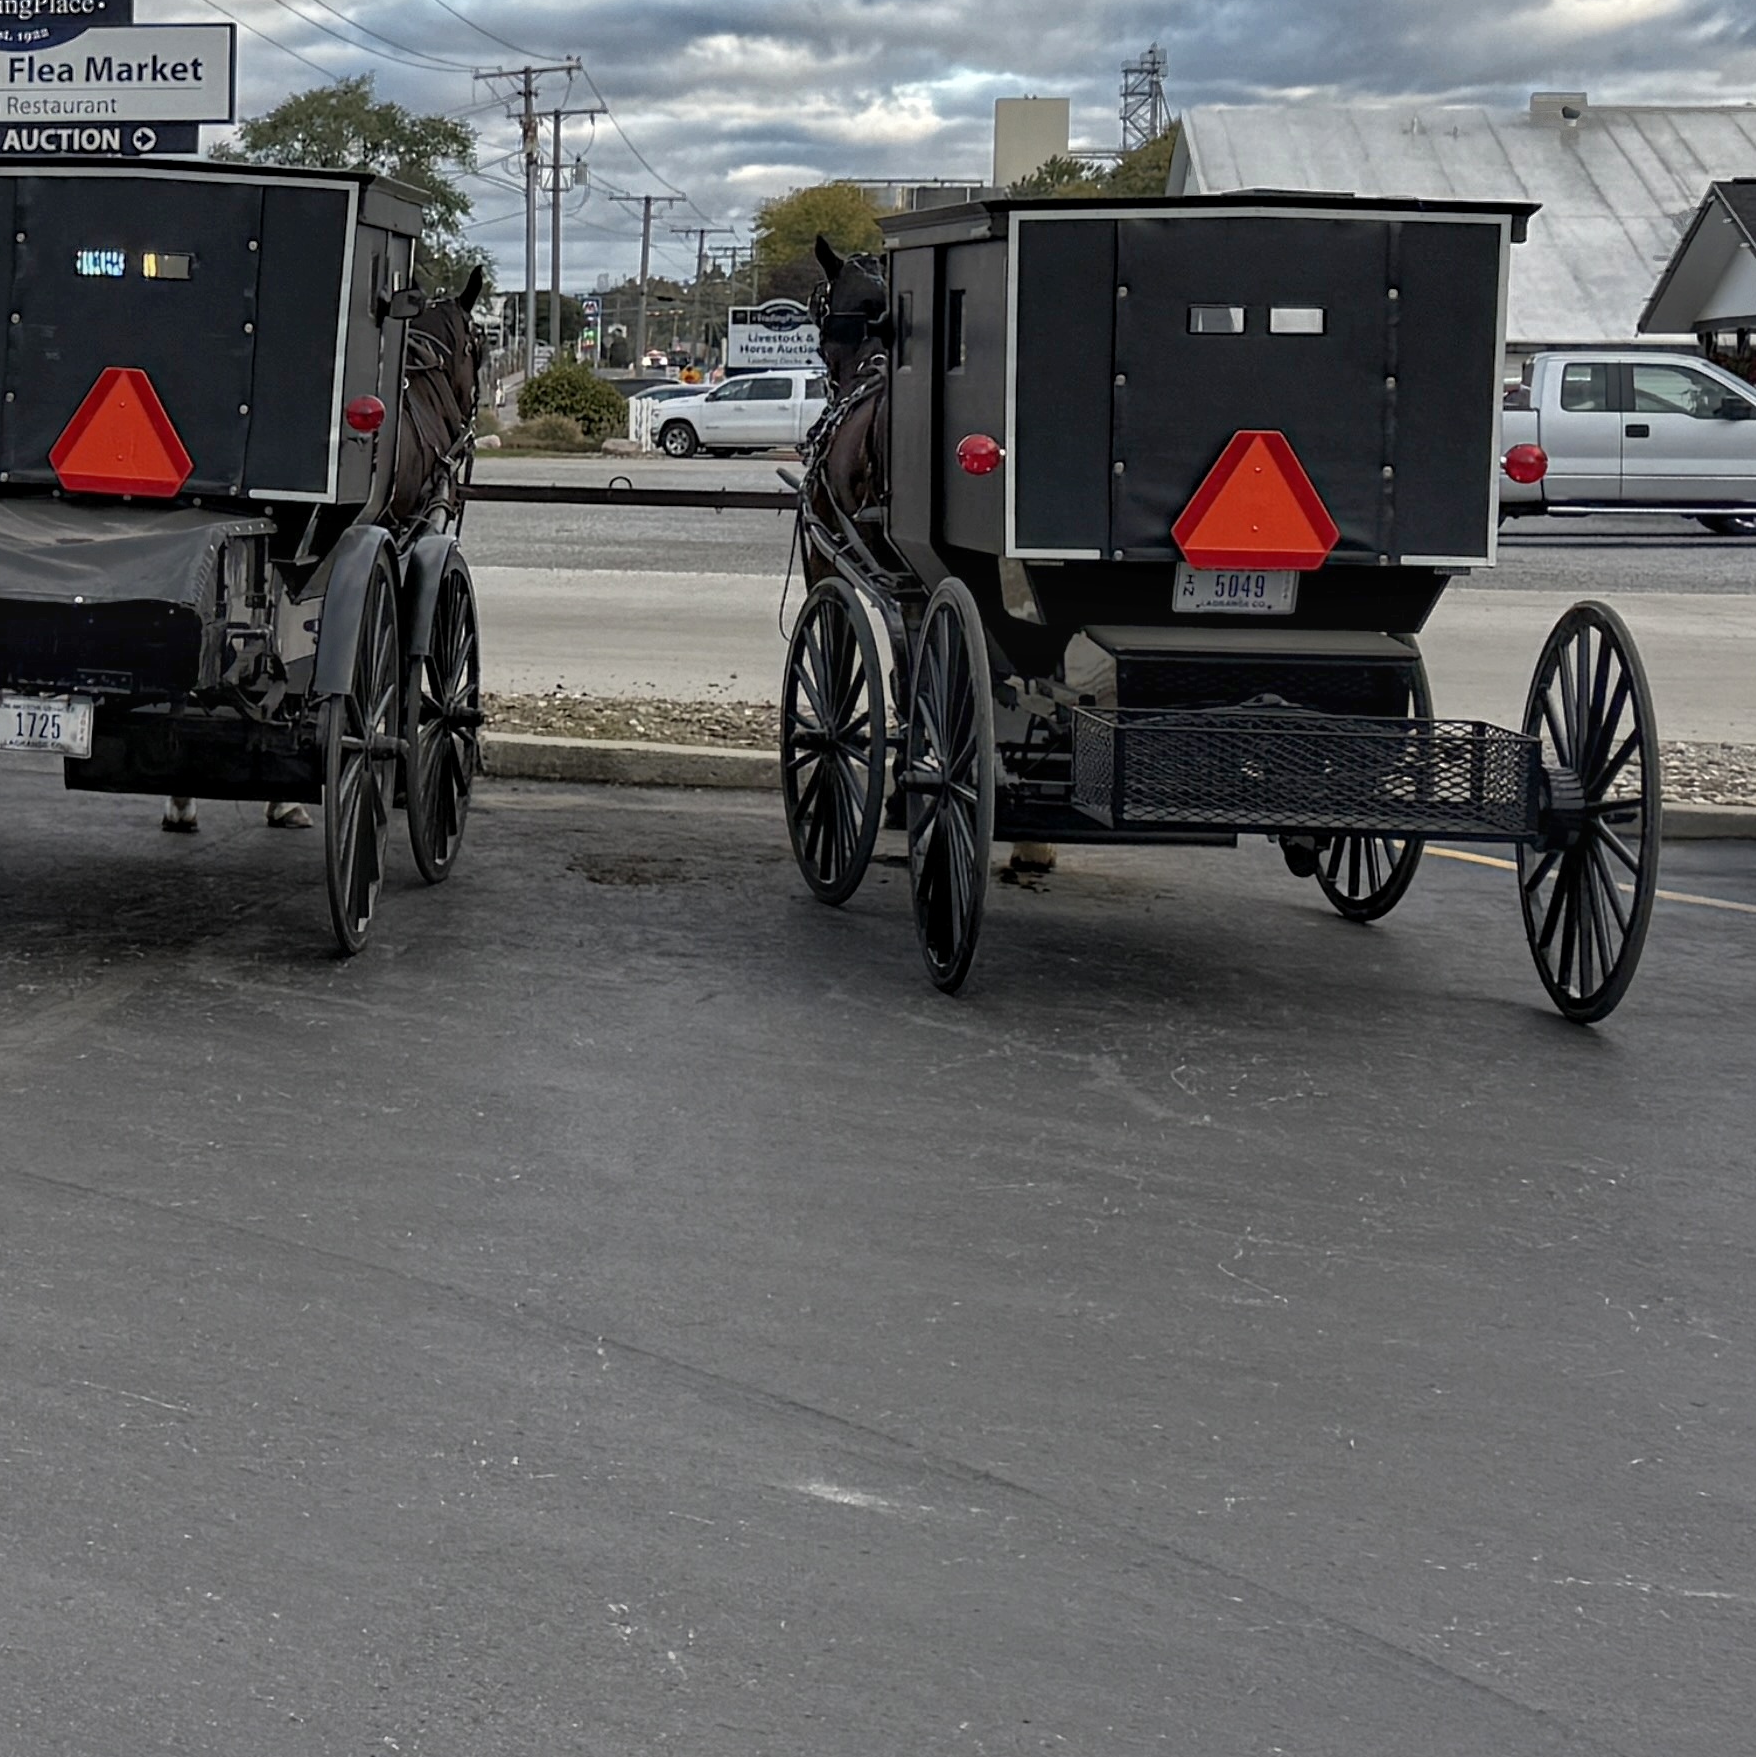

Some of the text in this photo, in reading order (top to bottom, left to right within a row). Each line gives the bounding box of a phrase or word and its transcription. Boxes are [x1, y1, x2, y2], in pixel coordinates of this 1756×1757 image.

[9, 56, 75, 84] Flea
[85, 54, 203, 82] Market
[7, 96, 117, 115] Restaurant
[2, 127, 121, 153] AUCTION
[748, 332, 803, 342] Livestock
[740, 345, 819, 354] Horse Auctio
[1215, 574, 1265, 598] 5049
[16, 712, 61, 739] 1725
